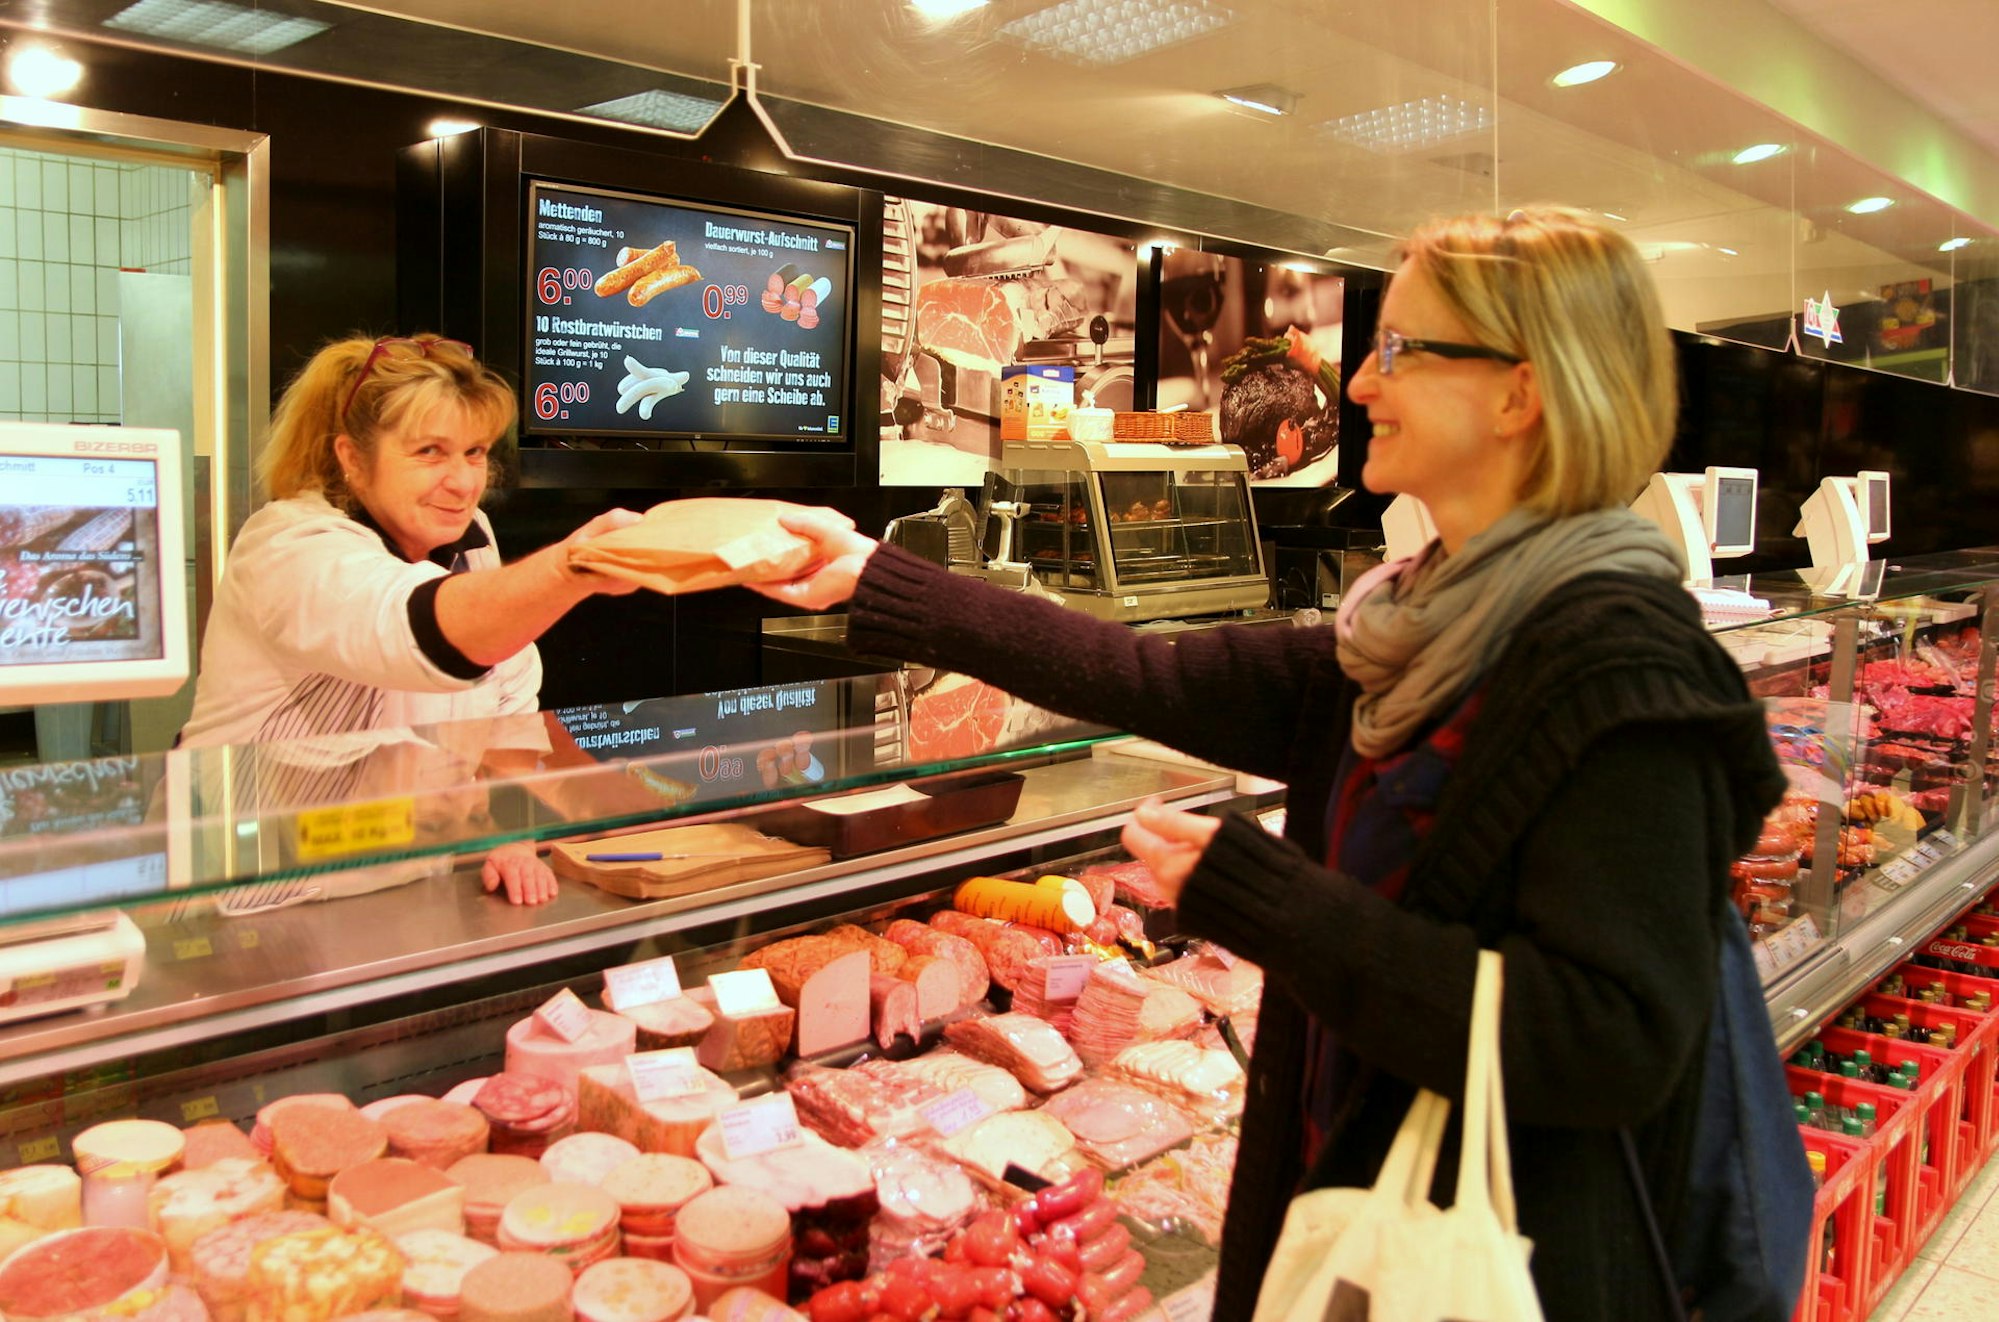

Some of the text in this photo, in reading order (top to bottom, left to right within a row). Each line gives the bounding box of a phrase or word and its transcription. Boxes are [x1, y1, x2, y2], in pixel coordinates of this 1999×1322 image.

[539, 198, 603, 224] Mettenden
[538, 222, 625, 239] aromatisch geräuchert, 10
[705, 221, 818, 251] Dauerwurst-Aufschnitt
[538, 231, 558, 241] Stück
[575, 237, 581, 245] g
[601, 240, 607, 248] g
[704, 242, 774, 259] vielfach sortiert, je 100 g
[536, 316, 549, 333] 10
[552, 316, 662, 341] Rostbratwürstchen
[536, 338, 622, 350] grob oder fein gebrüht, die
[536, 347, 608, 359] ideale Grillwurst, je 10
[720, 345, 820, 368] Von dieser Qualität
[535, 356, 555, 366] Stück
[563, 358, 575, 367] 100
[576, 360, 581, 369] g
[594, 361, 603, 370] kg
[706, 365, 831, 387] schneiden wir uns auch
[714, 386, 826, 406] gern eine Scheibe ab.
[74, 441, 158, 453] BIZERBA
[83, 463, 104, 474] Pos
